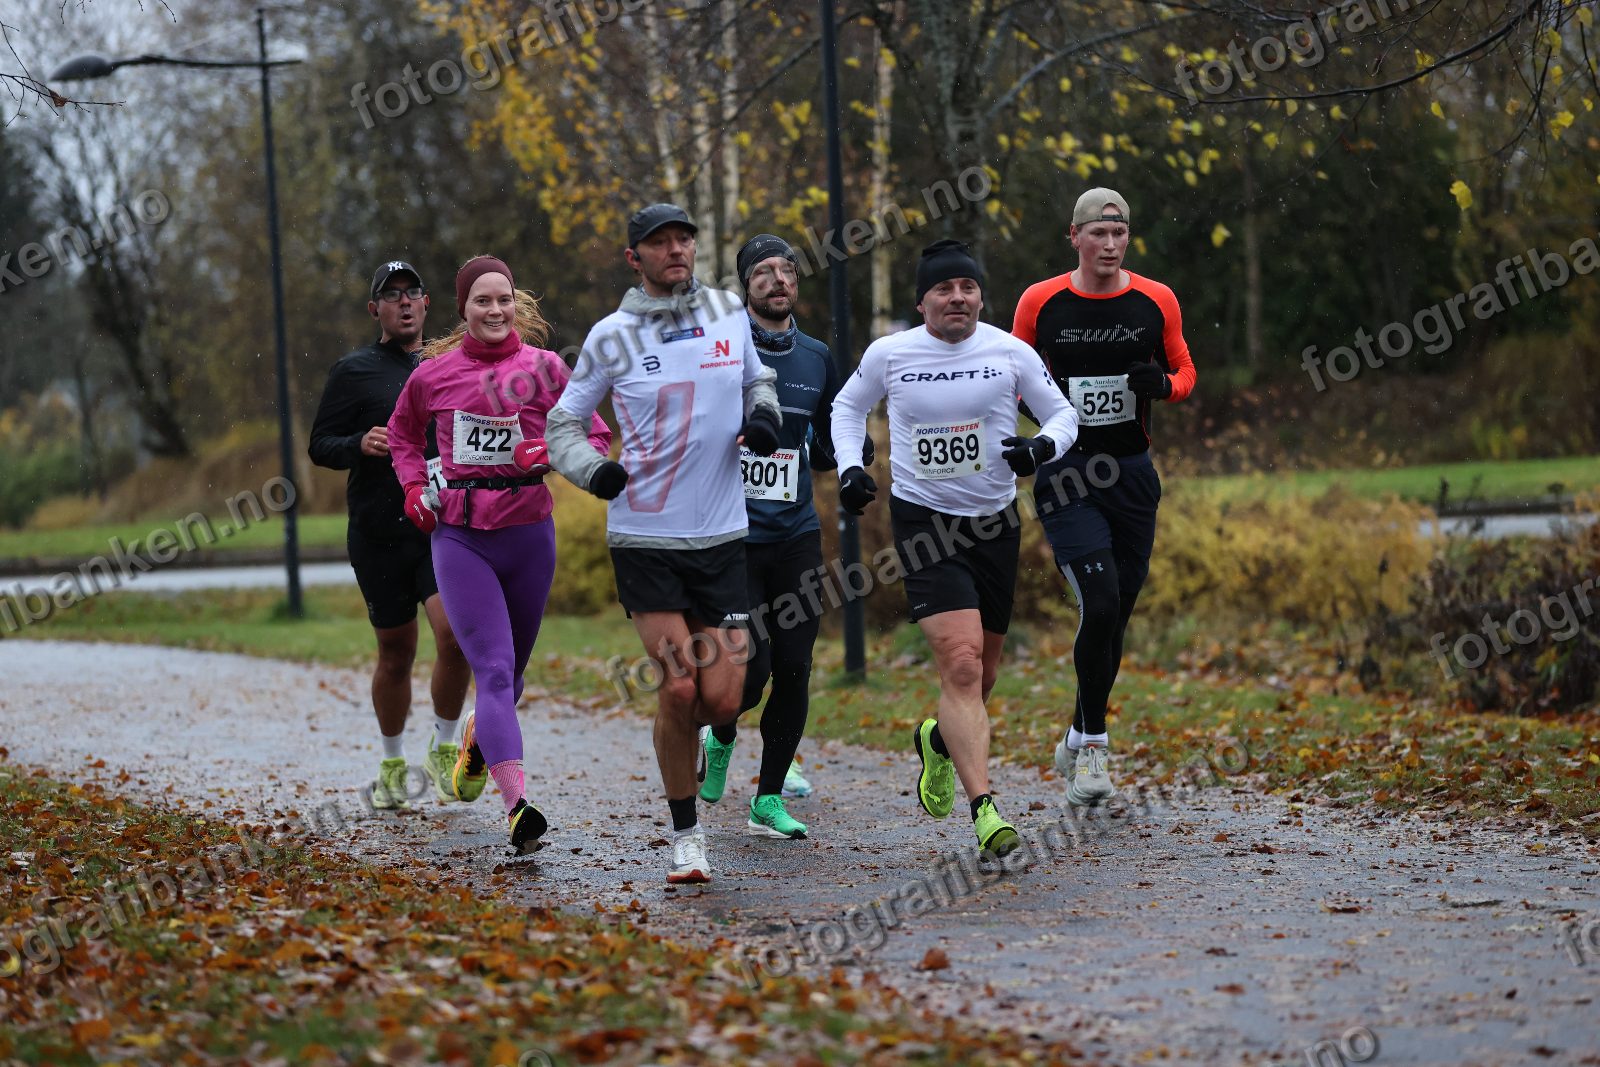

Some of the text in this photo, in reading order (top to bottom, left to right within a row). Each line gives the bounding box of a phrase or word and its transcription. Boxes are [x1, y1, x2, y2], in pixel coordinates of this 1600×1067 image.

[900, 369, 980, 382] CRAFT
[1083, 391, 1123, 416] 525
[460, 415, 519, 426] NORGESTESTEN
[916, 421, 980, 436] NORGESTESTEN
[466, 426, 512, 453] 422
[917, 433, 980, 466] 9369
